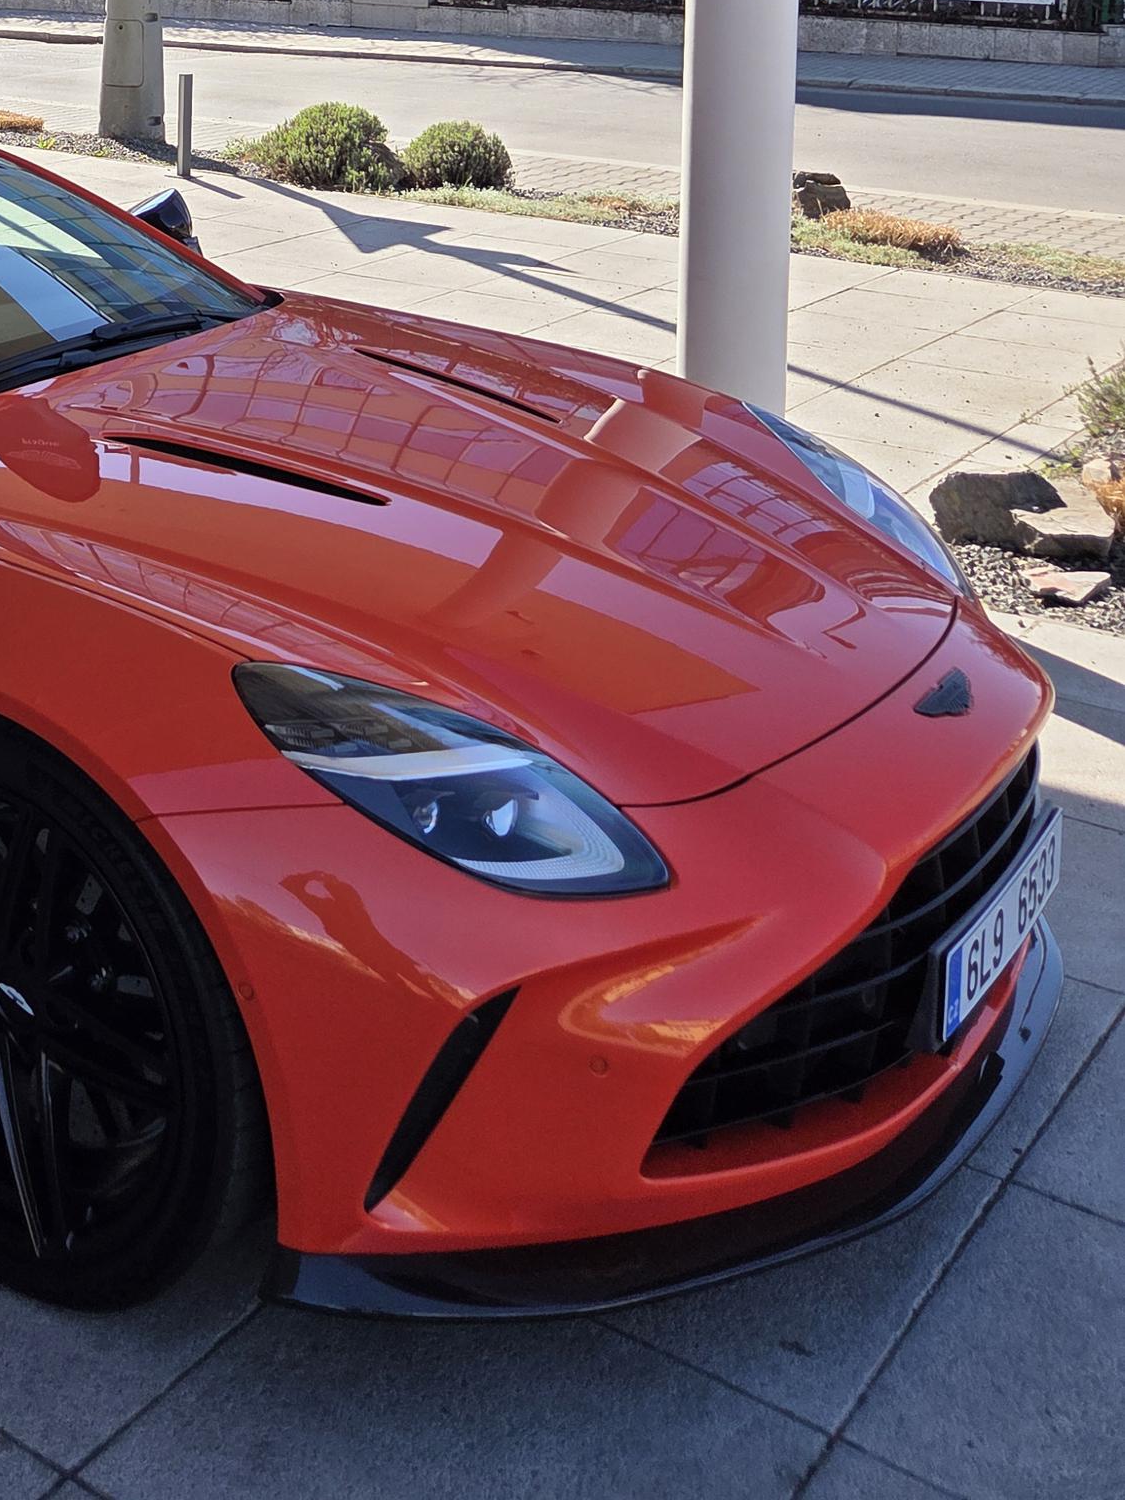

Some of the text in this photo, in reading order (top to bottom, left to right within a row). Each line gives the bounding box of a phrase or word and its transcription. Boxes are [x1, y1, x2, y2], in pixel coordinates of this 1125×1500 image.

[966, 833, 1056, 1002] 6L9 6533
[947, 998, 960, 1024] CZ
